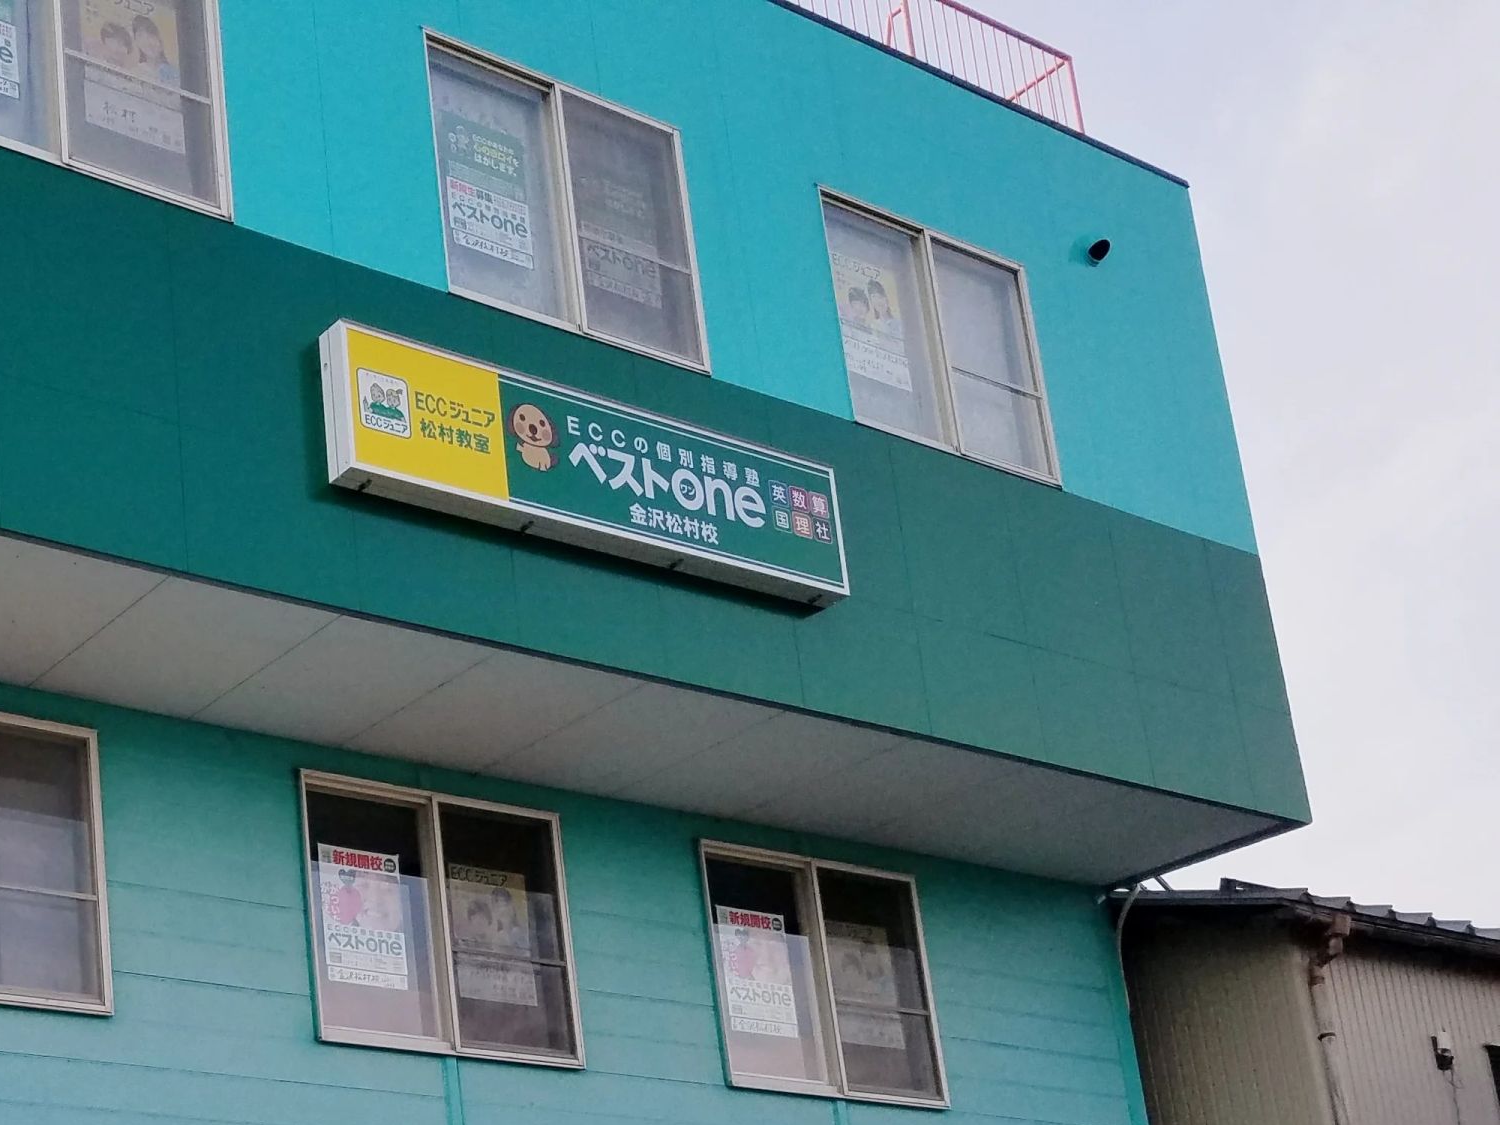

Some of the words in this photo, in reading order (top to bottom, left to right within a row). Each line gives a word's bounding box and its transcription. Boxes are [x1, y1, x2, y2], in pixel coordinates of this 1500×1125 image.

[452, 201, 529, 238] ベストone
[415, 391, 496, 429] ECCジュニア
[420, 418, 491, 455] 松村教室
[566, 416, 760, 487] ECCの個別指導塾
[568, 442, 767, 528] ベストone
[628, 502, 719, 545] 金沢松村校
[333, 850, 383, 871] 新規開校
[729, 911, 771, 930] 新規開校
[328, 932, 402, 956] ベストone
[730, 986, 791, 1007] ベストone
